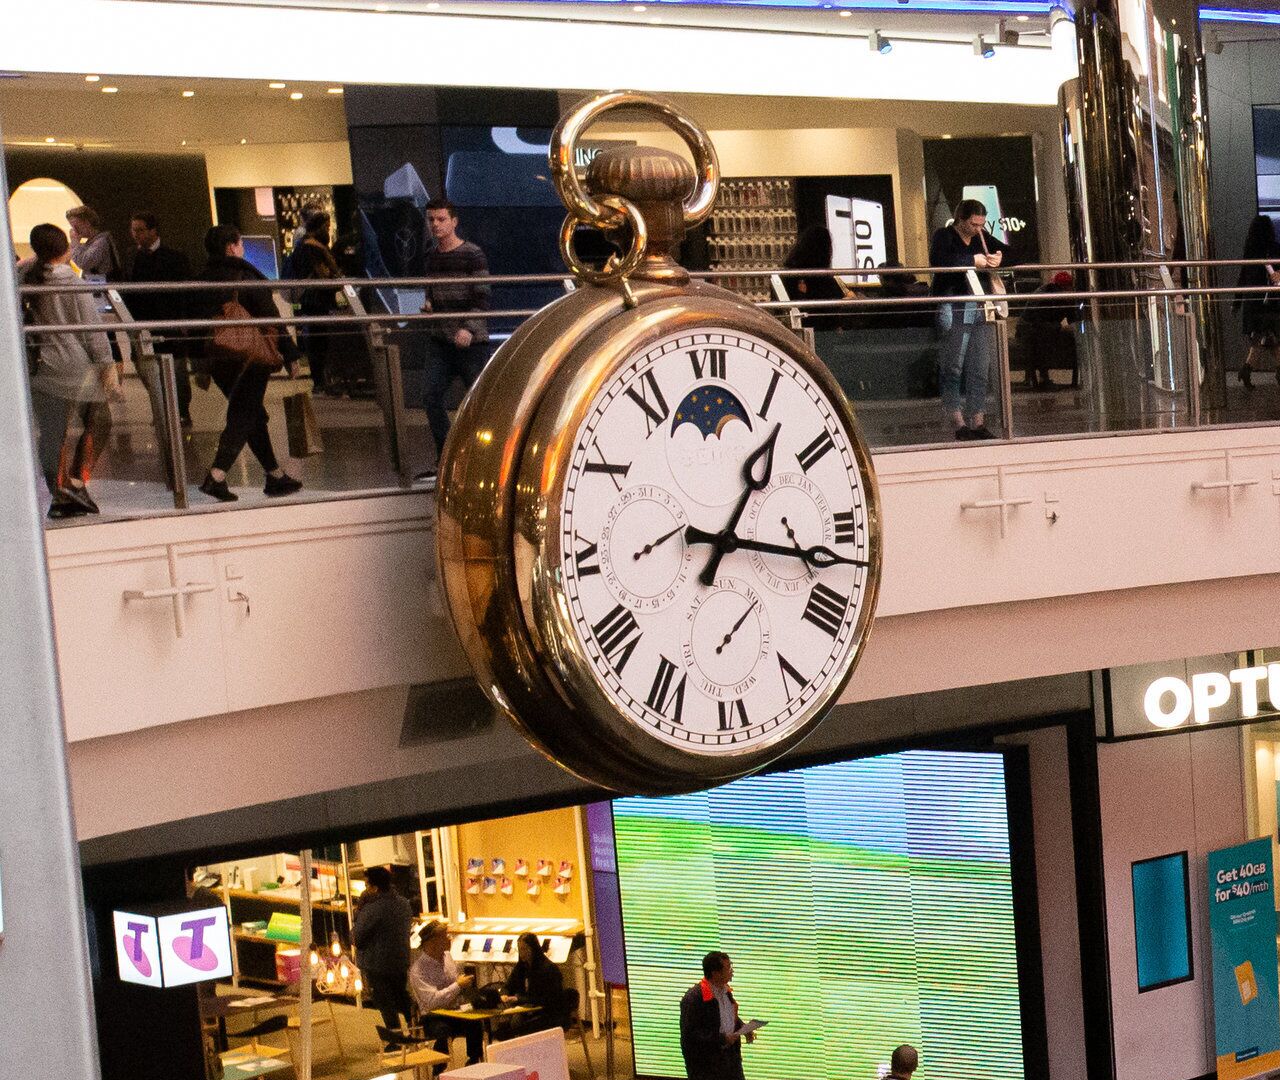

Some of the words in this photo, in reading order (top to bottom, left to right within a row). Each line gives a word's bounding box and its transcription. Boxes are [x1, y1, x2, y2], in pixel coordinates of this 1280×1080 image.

[623, 367, 670, 440] XI
[756, 367, 784, 421] I
[582, 436, 632, 492] X
[795, 425, 837, 475] II
[833, 507, 854, 546] III
[591, 604, 644, 680] VIII
[644, 653, 687, 725] VII
[776, 651, 810, 705] V
[717, 699, 753, 732] VI
[1215, 888, 1231, 903] for
[1231, 881, 1268, 897] $40/mth
[1217, 868, 1238, 884] Get
[1240, 863, 1266, 878] 40GB
